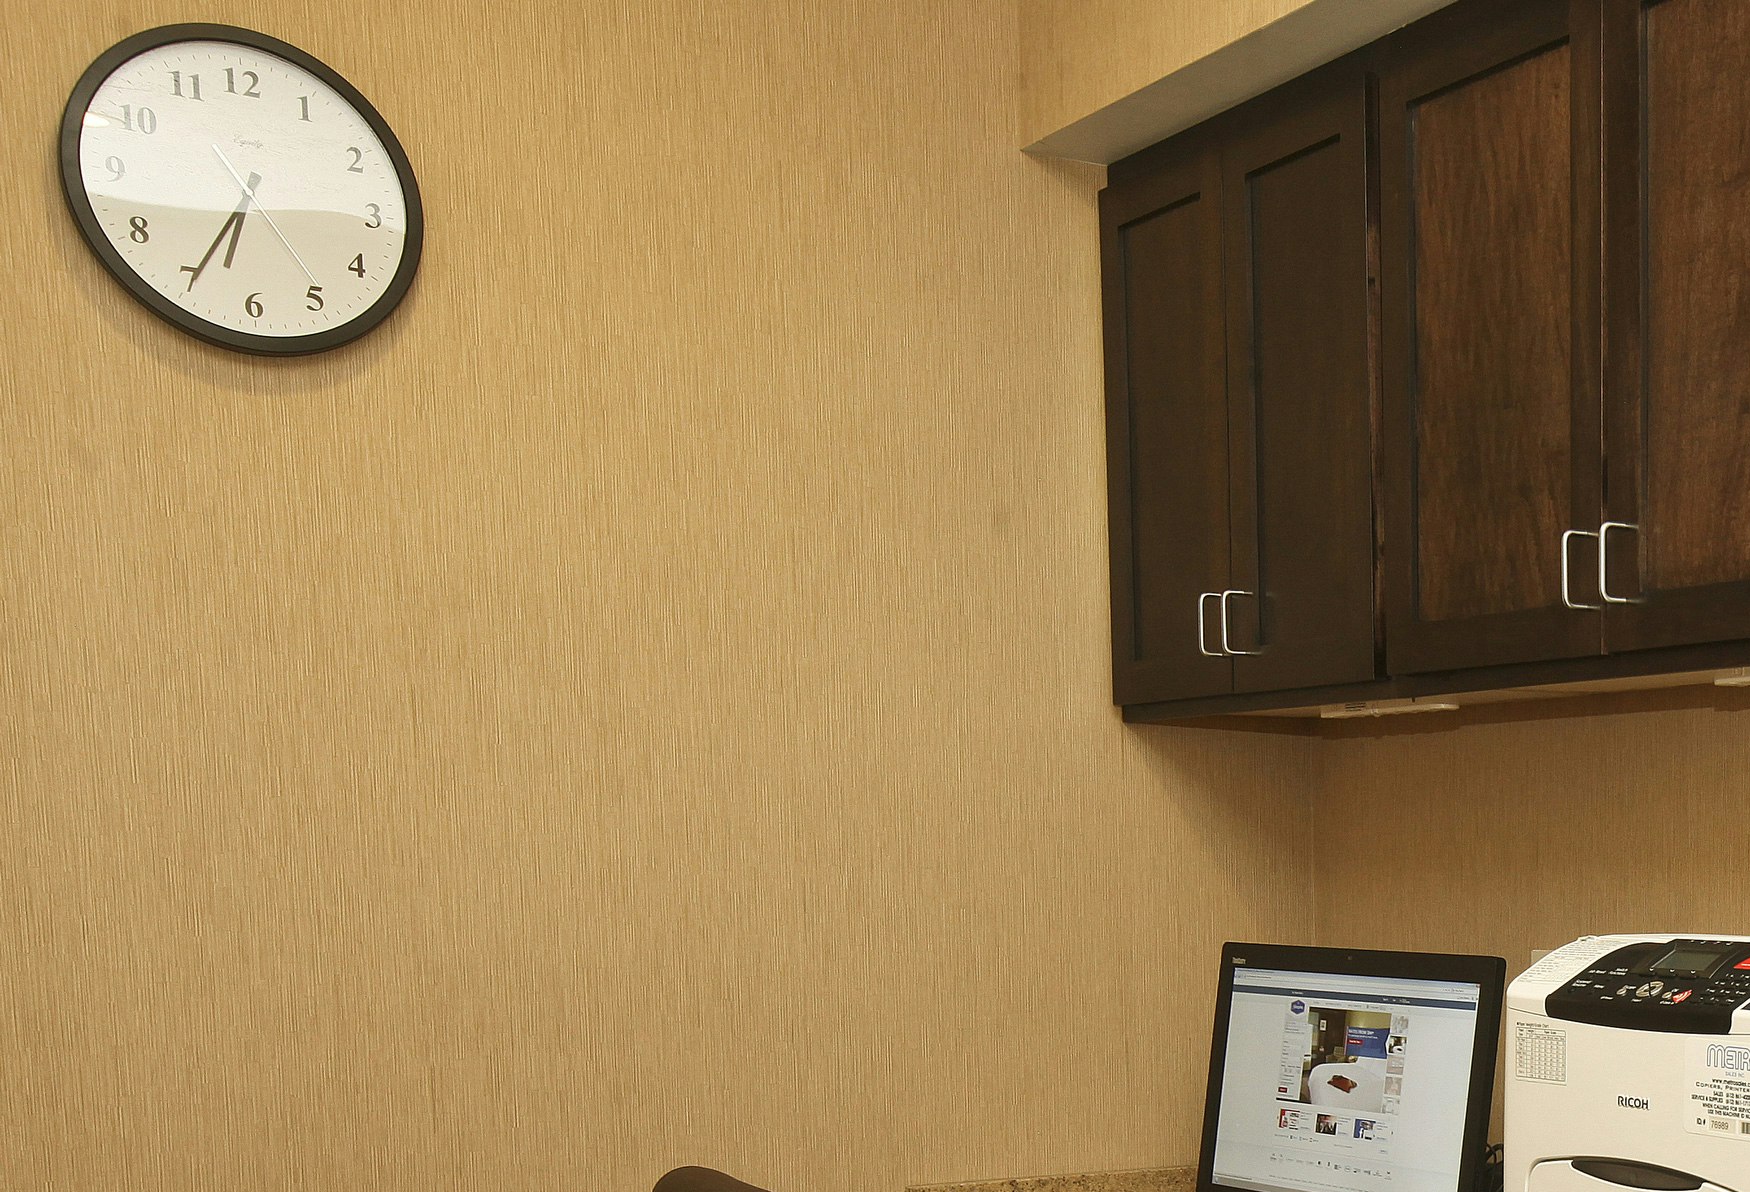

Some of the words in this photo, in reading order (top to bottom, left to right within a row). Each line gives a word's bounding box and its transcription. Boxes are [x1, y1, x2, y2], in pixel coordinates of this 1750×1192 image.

[169, 71, 205, 102] 11
[222, 67, 262, 99] 12
[119, 104, 157, 135] 10
[297, 96, 313, 122] 1
[105, 155, 126, 183] 9
[346, 147, 365, 173] 2
[364, 203, 382, 229] 3
[129, 216, 150, 244] 8
[348, 253, 366, 279] 4
[244, 292, 264, 318] 6
[305, 285, 324, 312] 5
[1618, 1095, 1649, 1110] RICOH
